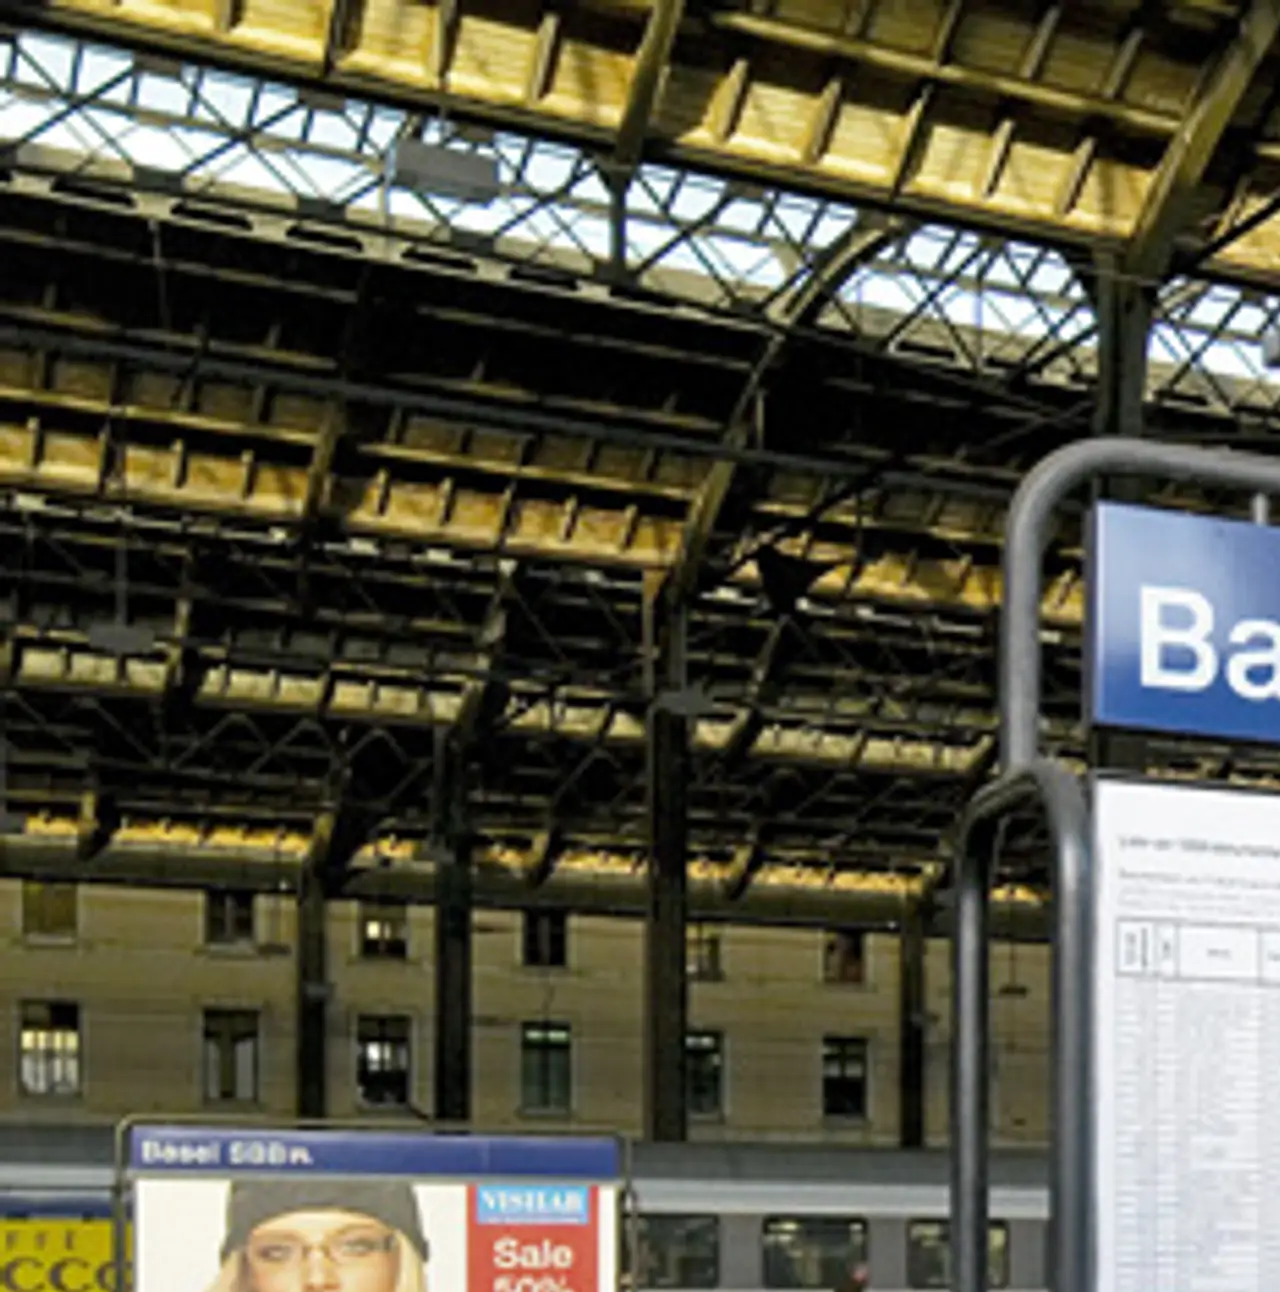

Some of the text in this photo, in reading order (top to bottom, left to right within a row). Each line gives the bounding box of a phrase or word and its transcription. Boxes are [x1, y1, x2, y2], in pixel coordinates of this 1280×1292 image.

[142, 1140, 221, 1165] Basel
[229, 1140, 287, 1165] SBB
[492, 1235, 574, 1269] Sale
